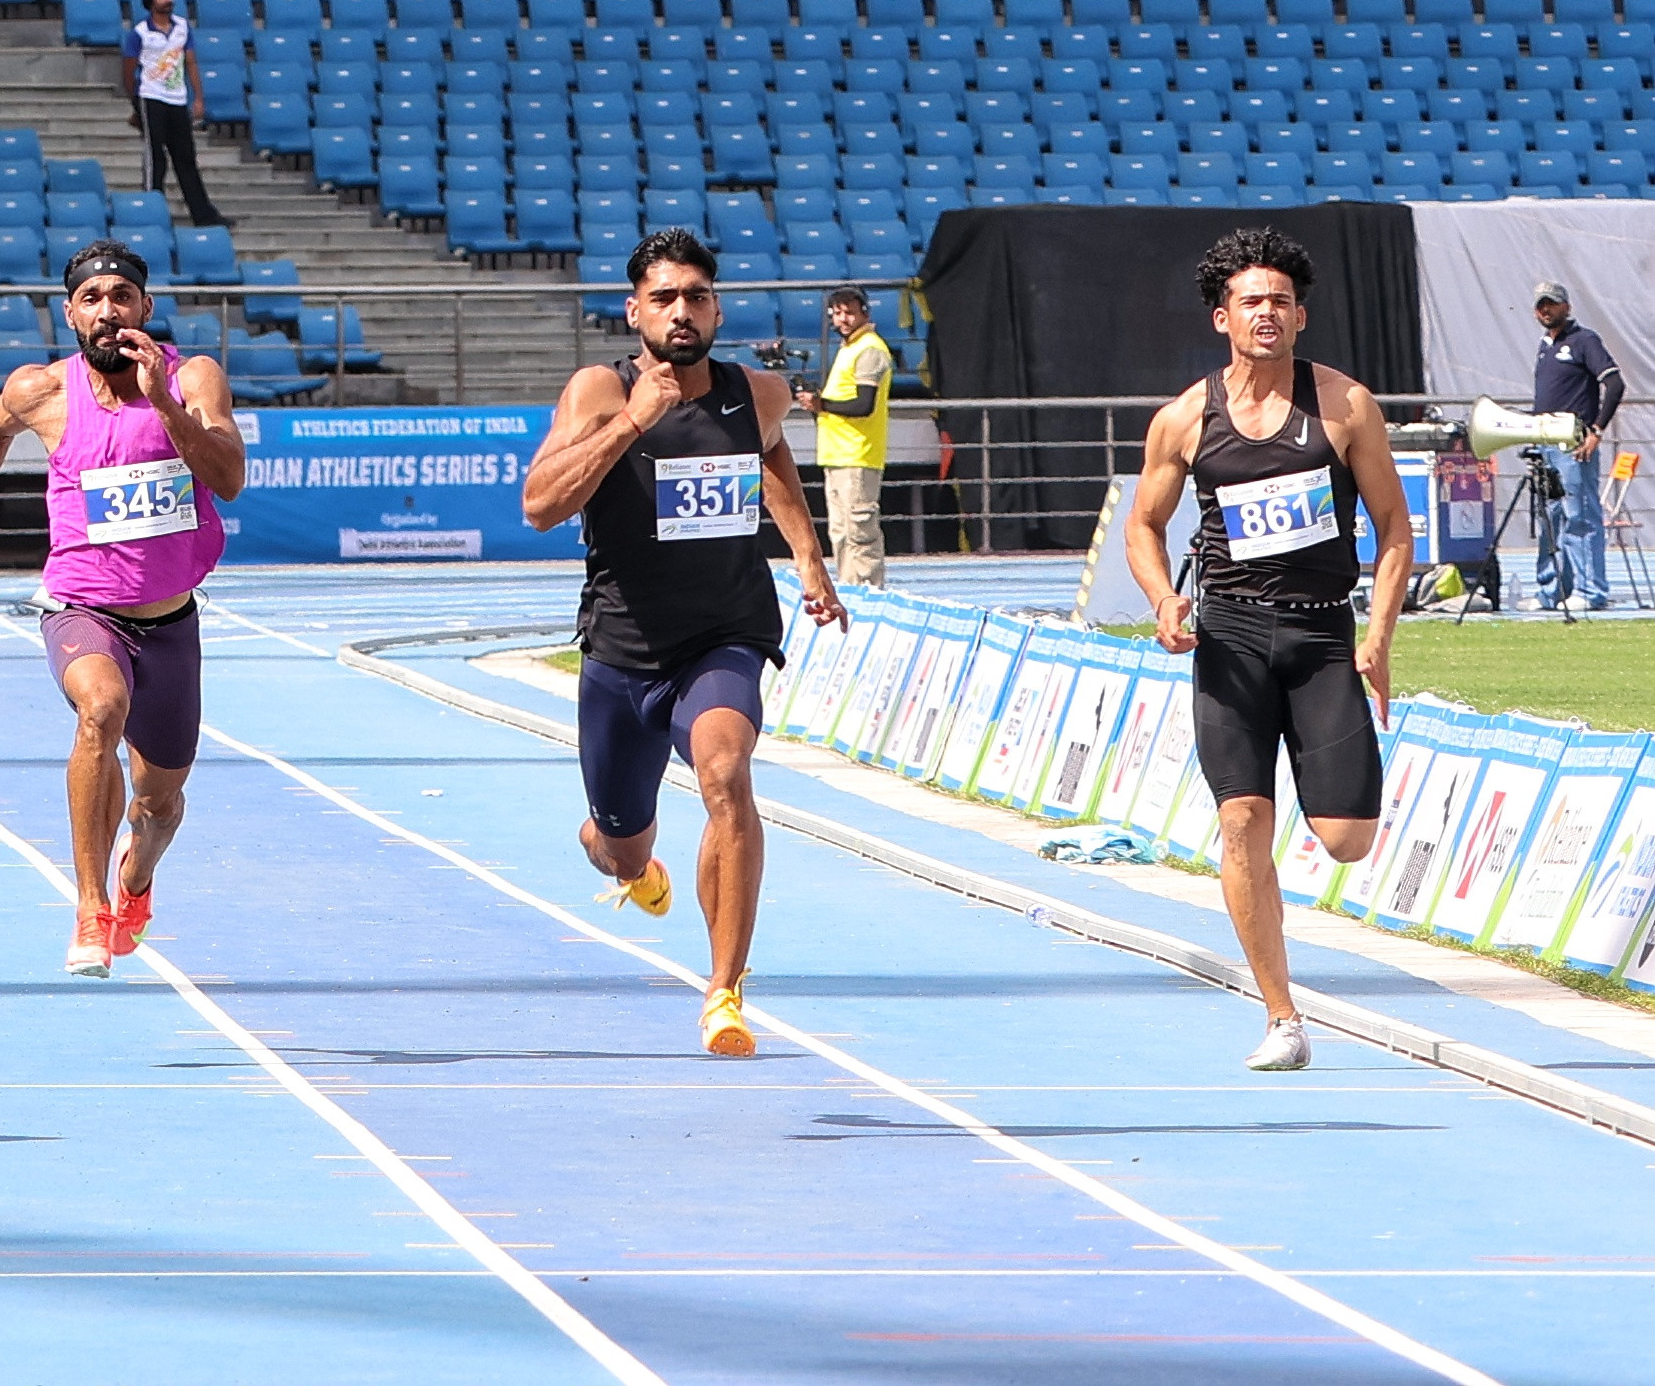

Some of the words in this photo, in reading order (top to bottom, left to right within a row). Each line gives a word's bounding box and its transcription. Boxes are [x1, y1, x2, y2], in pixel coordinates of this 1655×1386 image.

[292, 419, 370, 437] ATHLETICS
[372, 418, 461, 436] FEDERATION
[463, 417, 482, 435] OF
[485, 416, 529, 435] INDIA
[245, 456, 303, 488] DIAN
[305, 455, 419, 488] ATHLETICS
[420, 453, 499, 486] SERIES
[502, 453, 519, 485] 3
[102, 479, 176, 522] 345
[676, 476, 740, 518] 351
[1240, 492, 1313, 538] 861
